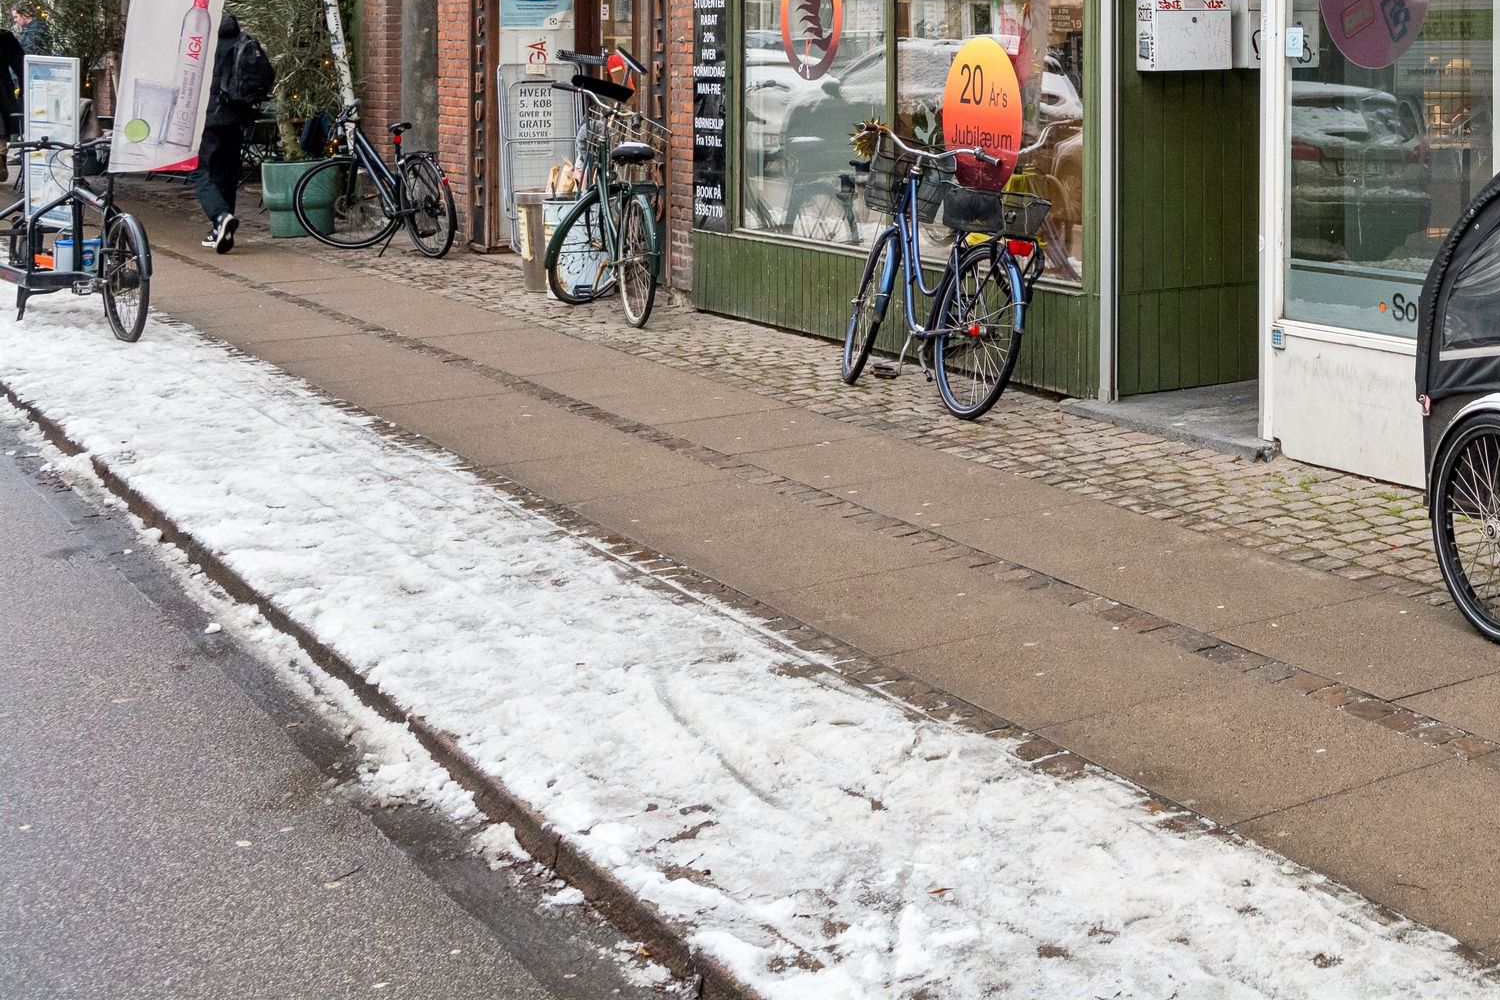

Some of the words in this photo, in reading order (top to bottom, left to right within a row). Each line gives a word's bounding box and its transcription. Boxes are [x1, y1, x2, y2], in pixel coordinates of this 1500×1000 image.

[700, 14, 718, 26] RABAT
[702, 32, 715, 43] 20%
[186, 36, 203, 61] AGA
[701, 49, 717, 60] HVER
[693, 66, 726, 77] FORMIDDAG
[697, 83, 721, 95] MAN-FRE
[960, 63, 984, 105] 20
[989, 81, 1008, 108] År's
[519, 88, 552, 97] HVERT
[519, 100, 528, 108] 5.
[533, 100, 552, 108] KØB
[519, 120, 552, 128] GRATIS
[694, 117, 724, 130] BØRNEKLIP
[696, 134, 705, 146] Fra
[705, 135, 715, 147] 150
[715, 135, 723, 147] kr.
[951, 124, 1012, 150] Jubilæum
[696, 185, 713, 199] BOOK
[713, 184, 721, 200] PÅ
[695, 203, 723, 218] 35367170
